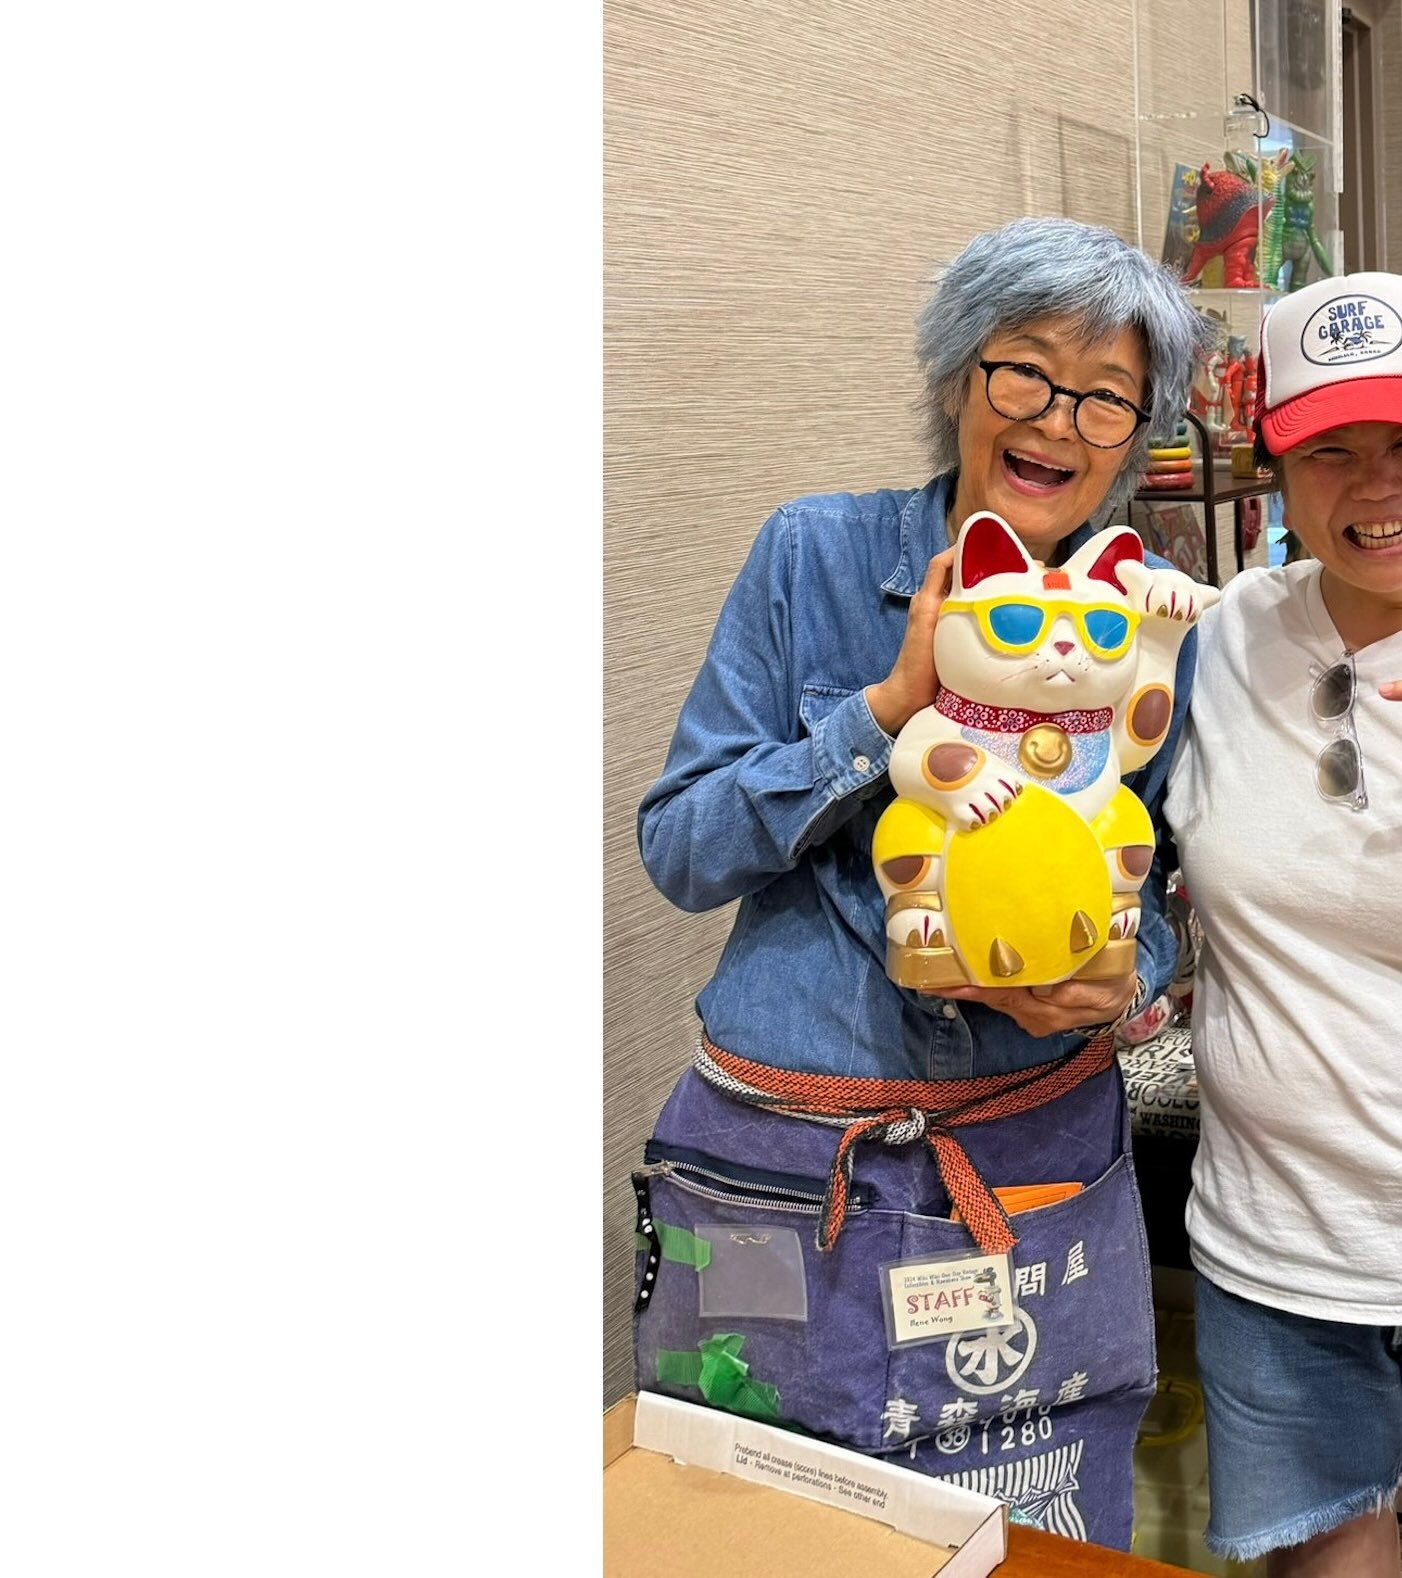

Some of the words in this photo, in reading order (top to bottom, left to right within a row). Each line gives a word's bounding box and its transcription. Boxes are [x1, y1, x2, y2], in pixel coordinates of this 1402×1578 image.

[1328, 301, 1368, 321] SURF
[1318, 315, 1385, 340] GARAGE
[906, 1286, 975, 1314] STAFF
